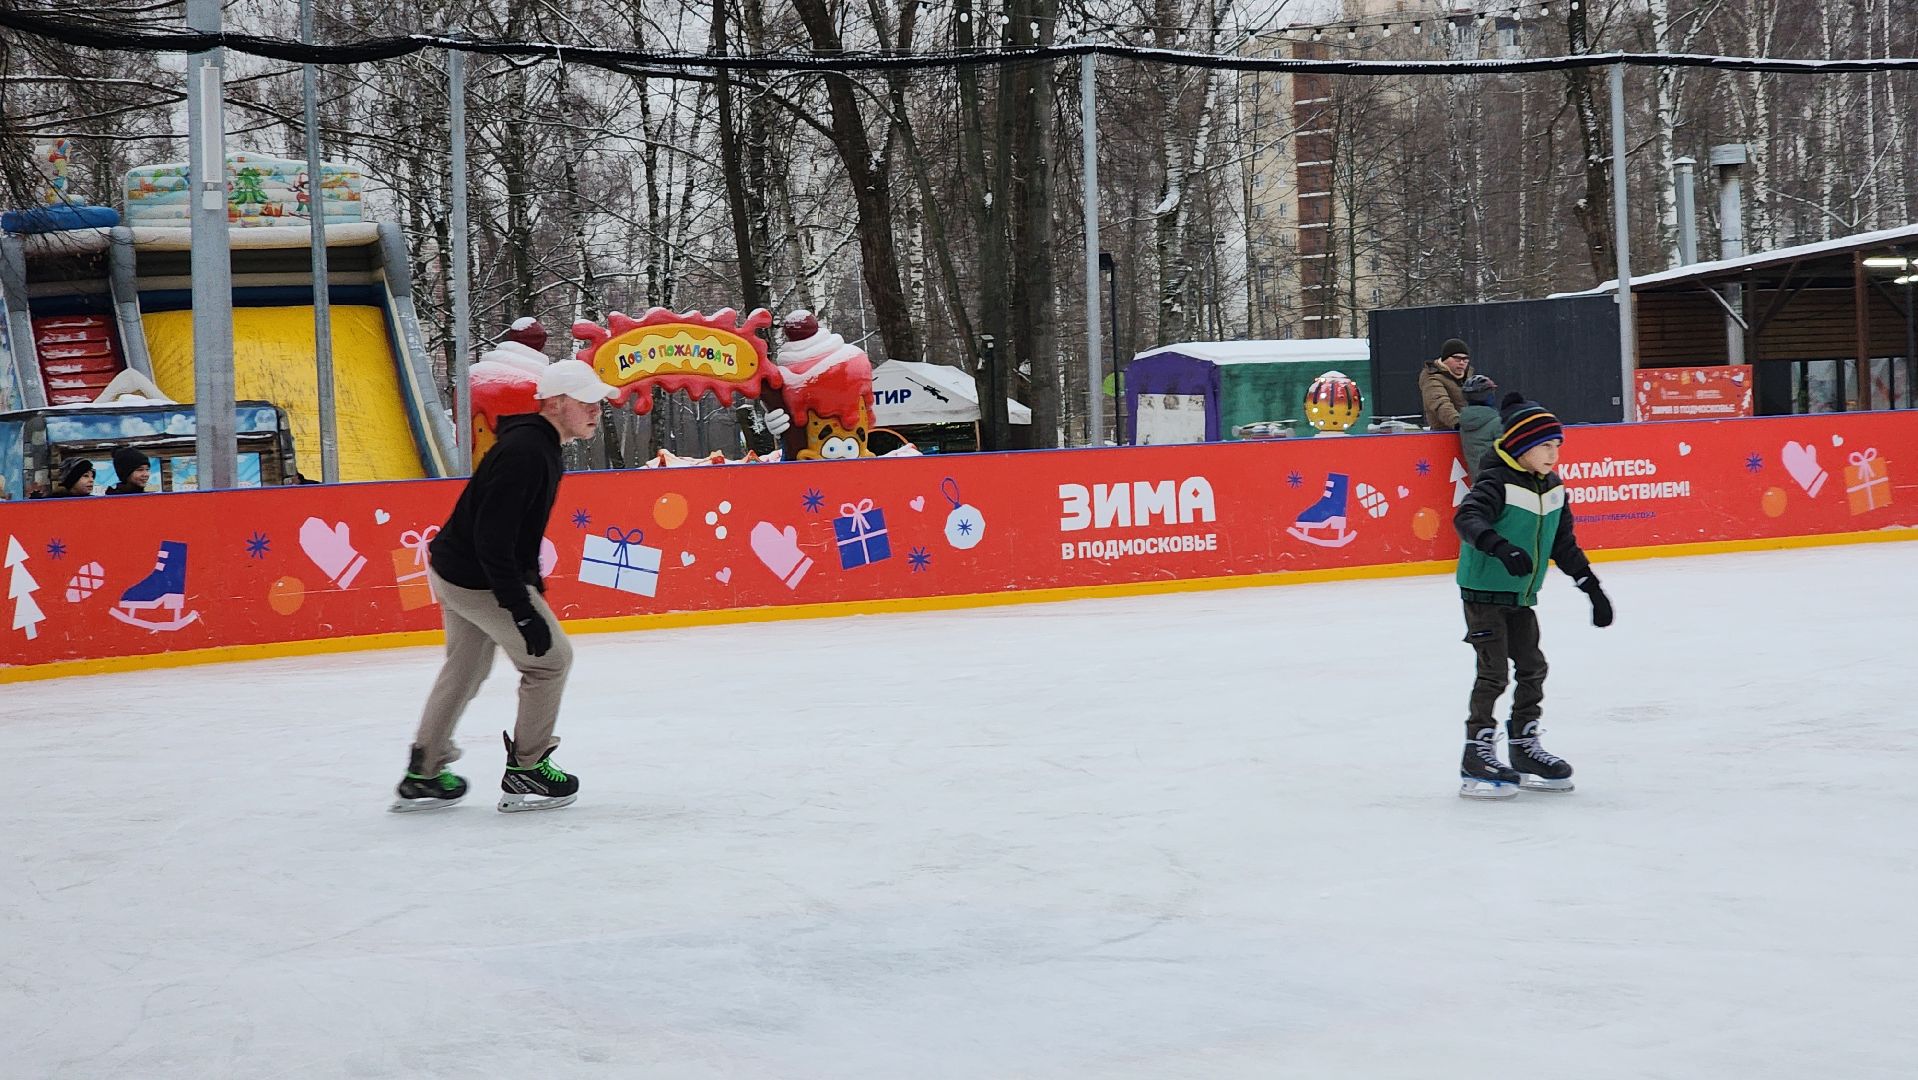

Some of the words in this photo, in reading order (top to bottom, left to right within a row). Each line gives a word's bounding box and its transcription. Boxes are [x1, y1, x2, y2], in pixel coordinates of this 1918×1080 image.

[658, 344, 735, 366] ПОЖАЛОВАТЬ
[873, 388, 912, 406] ТИР
[1558, 456, 1657, 480] КАТАЙТЕСЬ
[1058, 476, 1216, 531] ЗИМА
[1565, 480, 1691, 504] ОВОЛЬСТВИЕМ!
[1061, 543, 1075, 560] В
[1078, 533, 1218, 560] ПОДМОСКОВЬЕ
